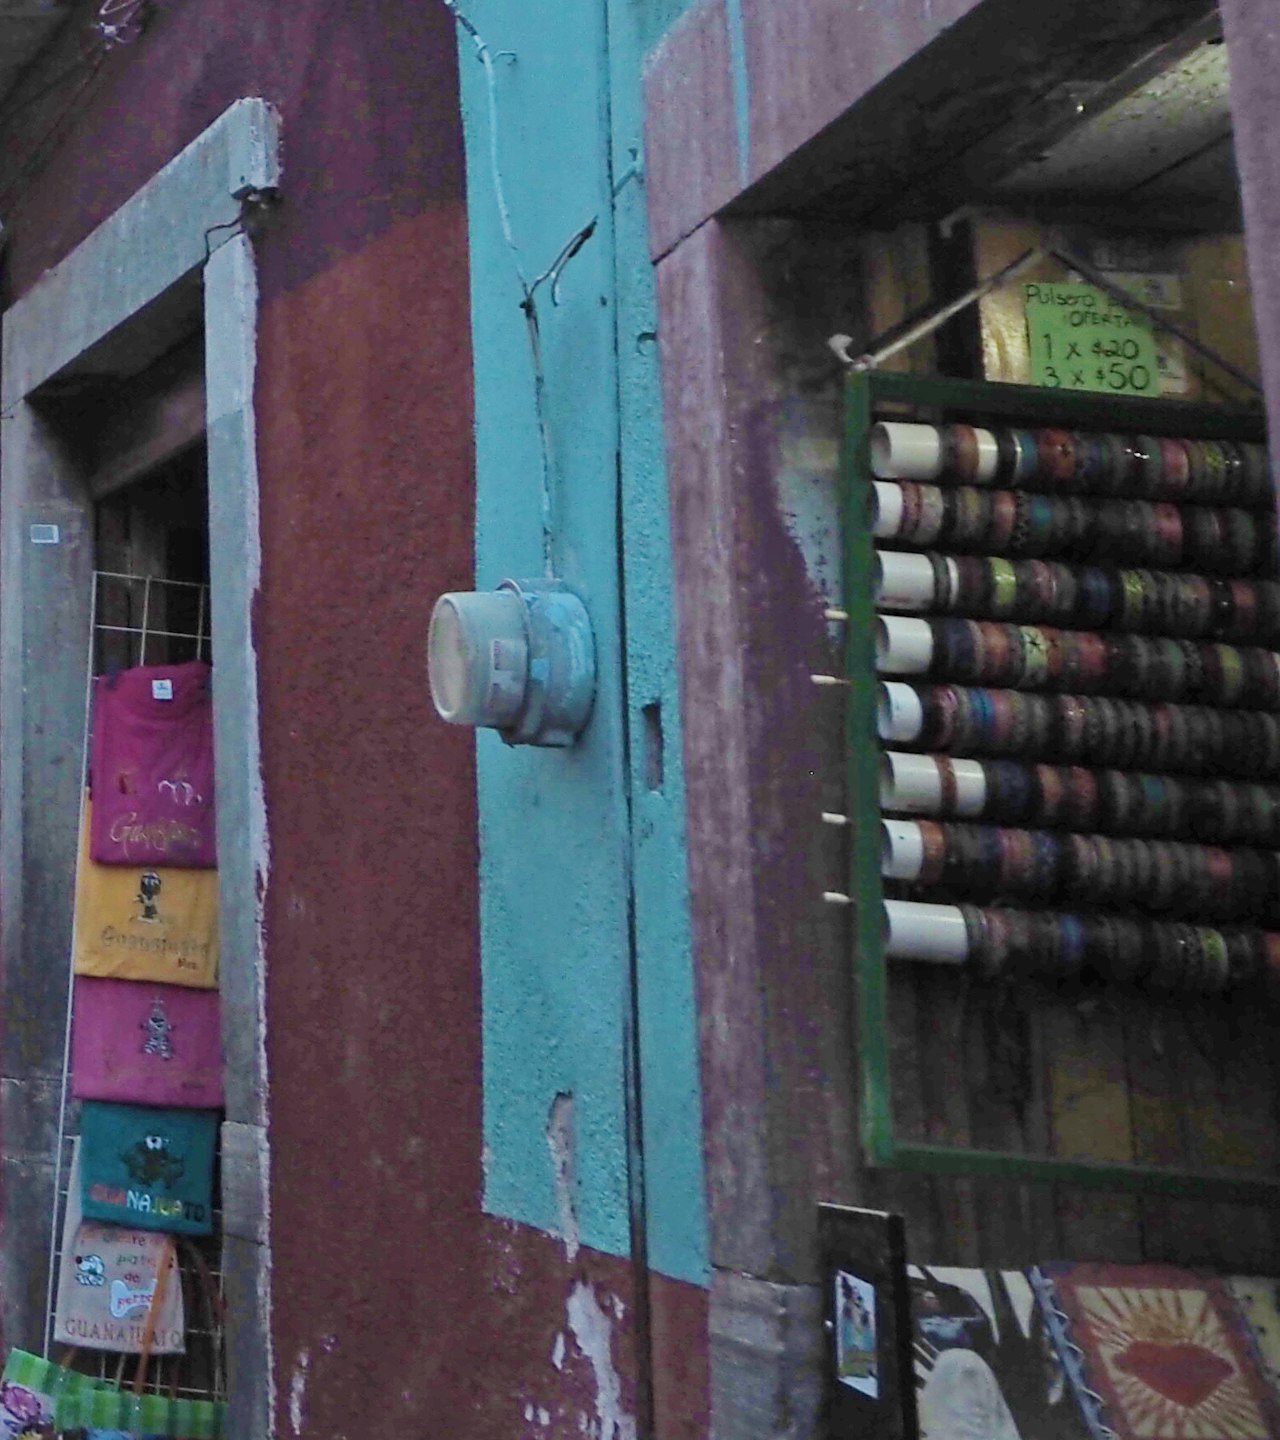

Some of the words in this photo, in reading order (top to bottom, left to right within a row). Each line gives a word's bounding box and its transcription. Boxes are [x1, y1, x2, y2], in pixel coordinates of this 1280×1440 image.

[1043, 333, 1053, 359] 1
[1092, 338, 1140, 360] $20
[1042, 366, 1061, 388] 3
[1095, 363, 1151, 390] $50
[90, 1183, 205, 1223] GUANAJUATO
